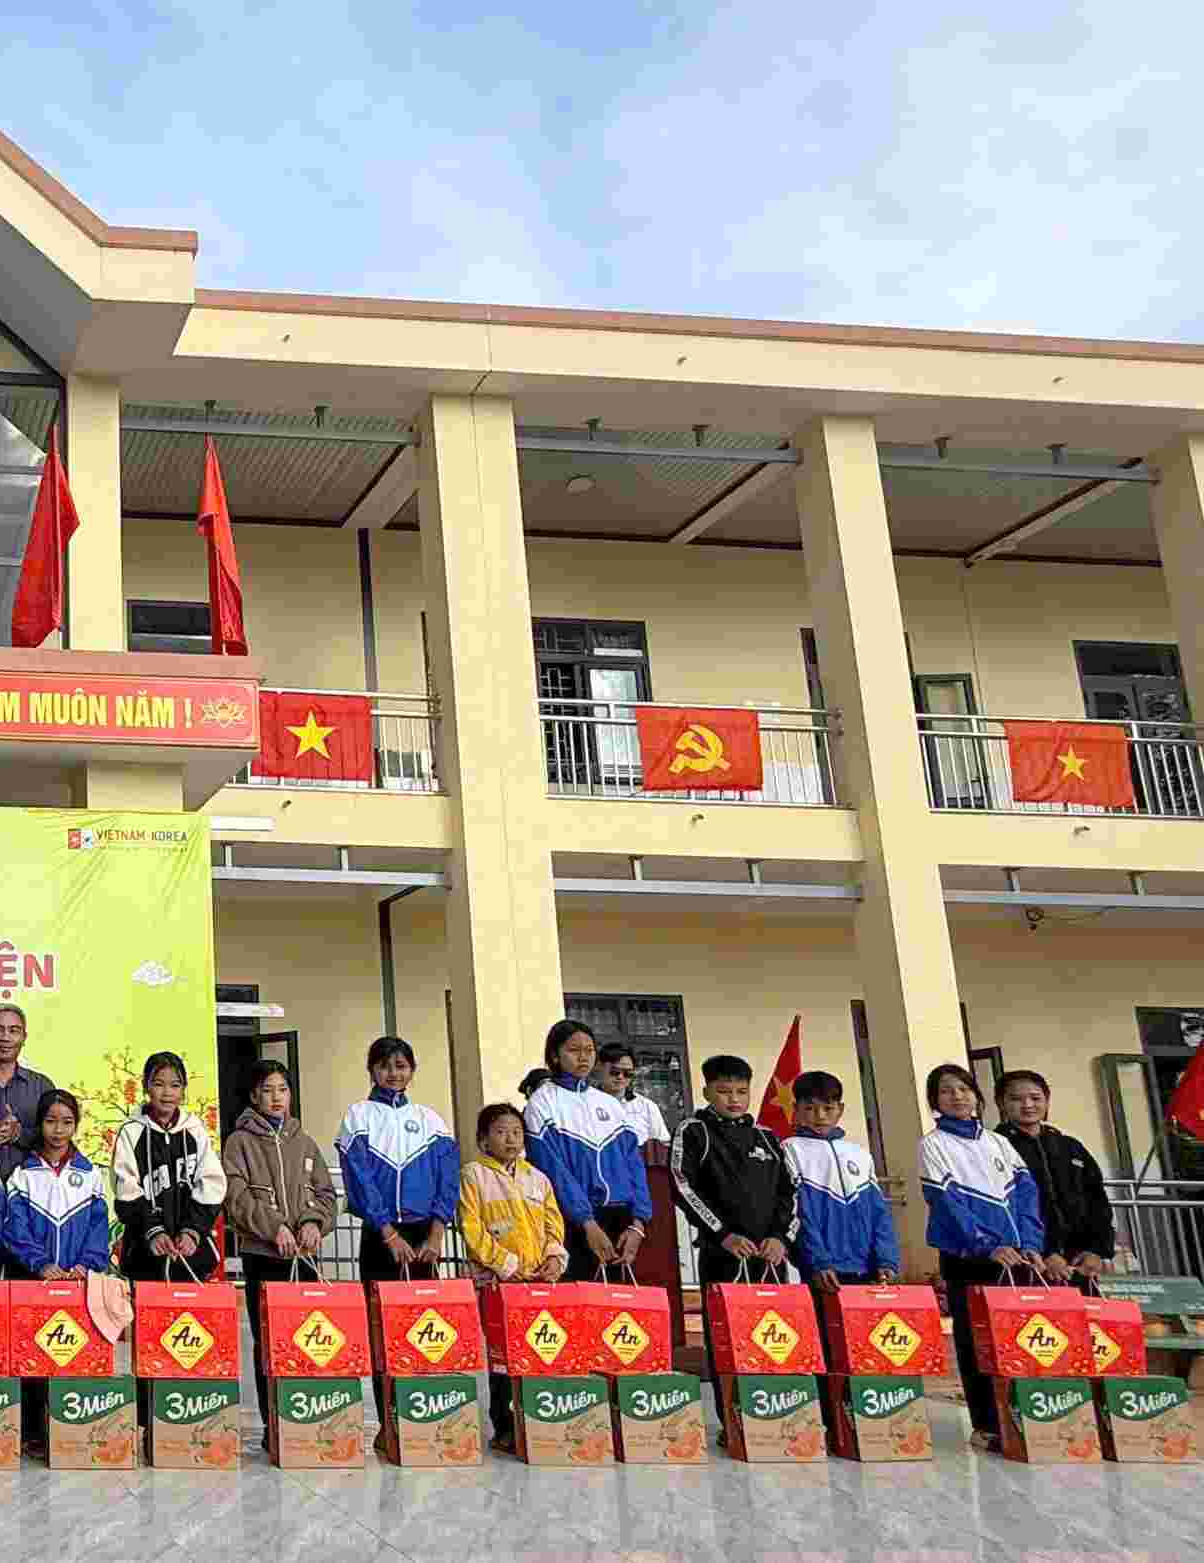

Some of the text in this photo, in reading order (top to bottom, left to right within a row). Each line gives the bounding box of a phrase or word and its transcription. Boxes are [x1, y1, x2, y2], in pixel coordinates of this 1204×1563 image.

[28, 687, 110, 728] MUÔN
[115, 689, 175, 729] NĂM
[96, 829, 146, 841] VIETNAM
[151, 830, 188, 841] KOREA
[46, 1323, 79, 1347] An
[171, 1325, 204, 1349] An
[304, 1323, 334, 1347] An
[417, 1322, 448, 1345] An
[534, 1323, 560, 1346] An
[611, 1324, 641, 1347] An
[761, 1323, 790, 1345] An
[879, 1325, 909, 1347] An
[1027, 1326, 1060, 1348] An
